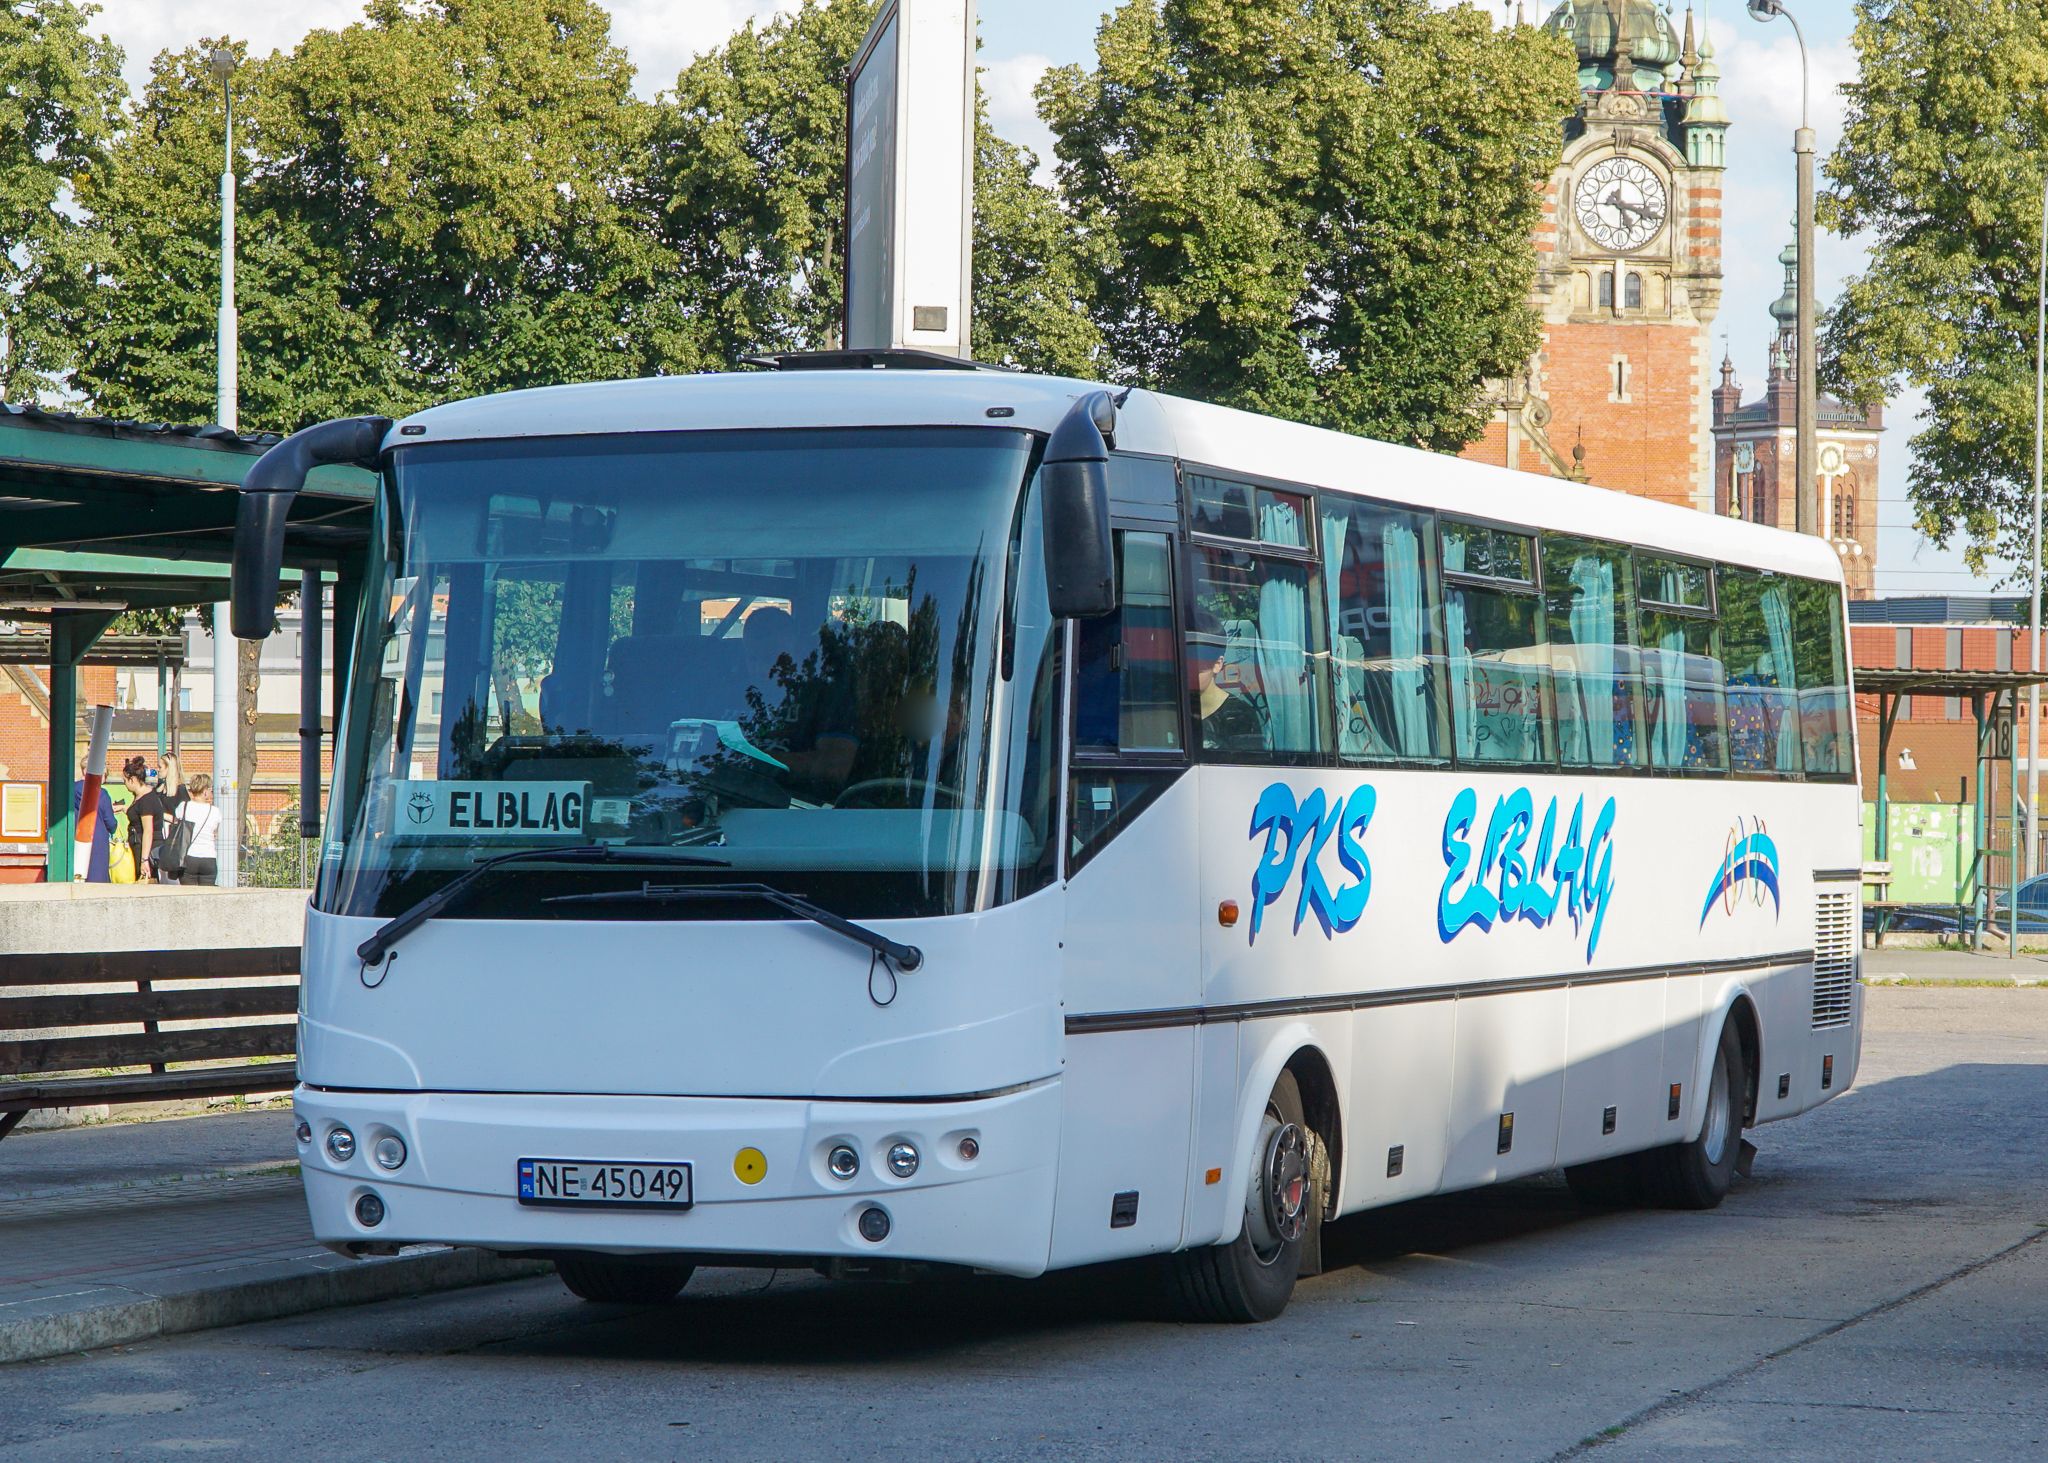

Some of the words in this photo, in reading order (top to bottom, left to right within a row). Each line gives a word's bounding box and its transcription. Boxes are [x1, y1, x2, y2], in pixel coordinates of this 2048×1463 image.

[2001, 720, 2010, 755] 8
[1249, 782, 1377, 948] PKS
[522, 1183, 533, 1193] PL
[538, 1165, 580, 1197] NE
[591, 1167, 684, 1200] 45049
